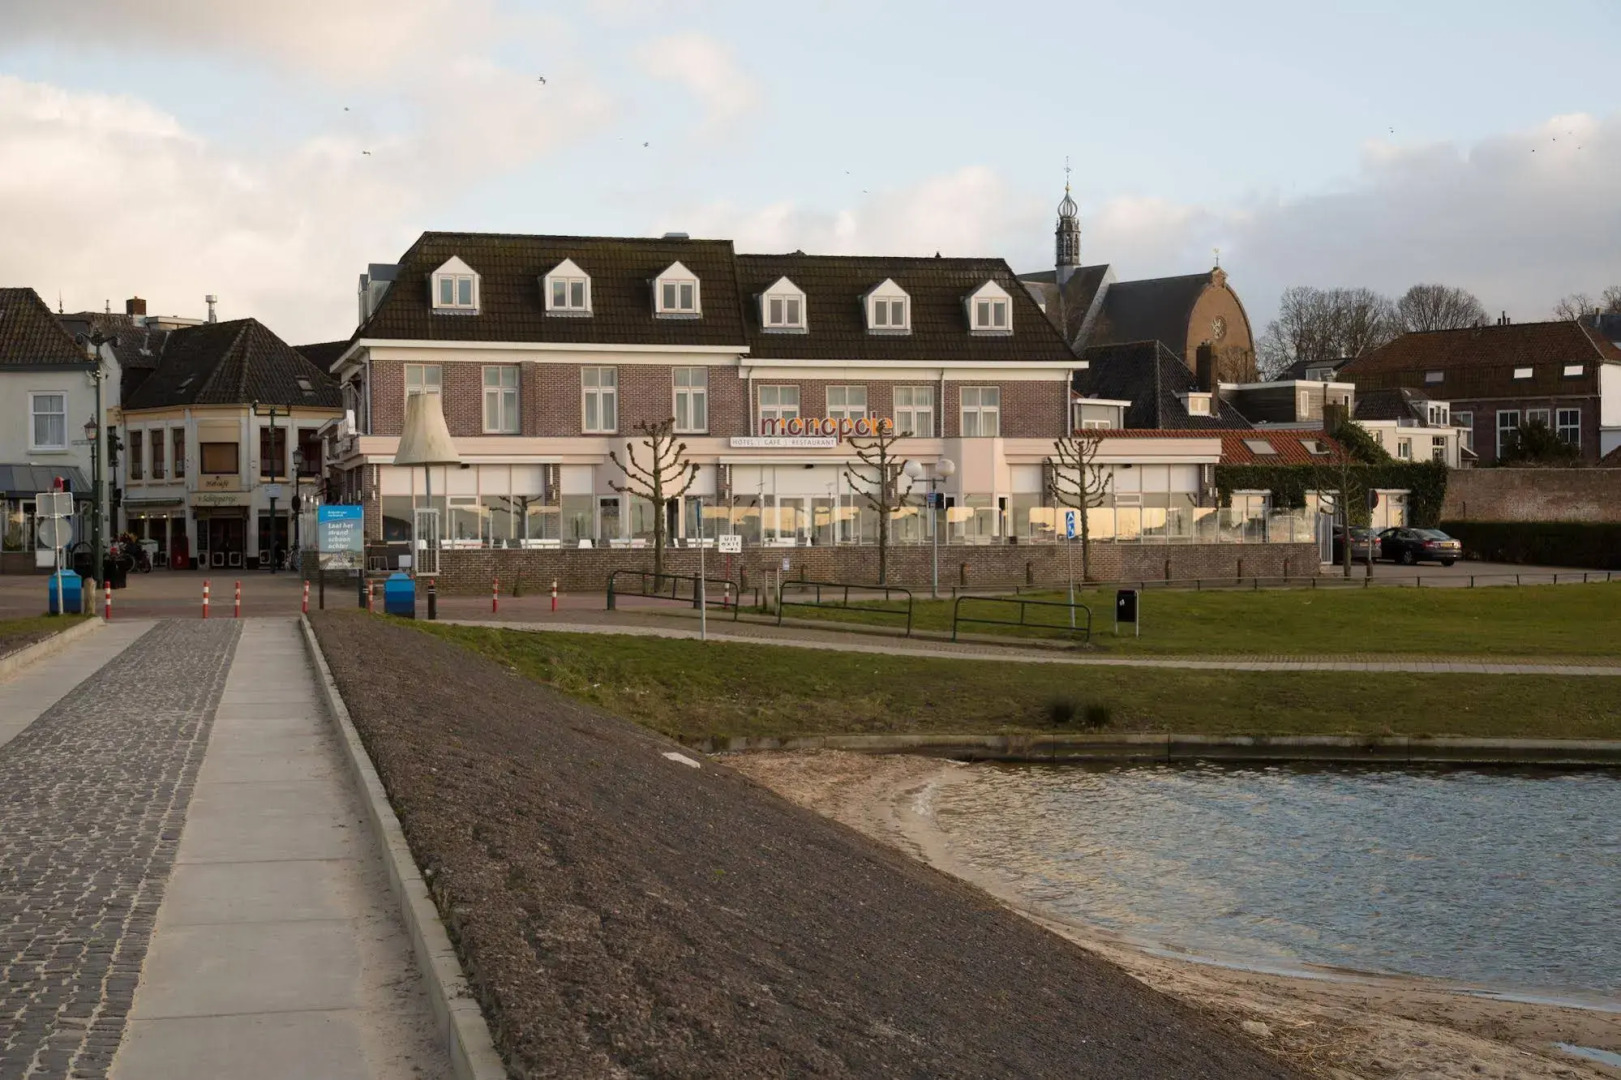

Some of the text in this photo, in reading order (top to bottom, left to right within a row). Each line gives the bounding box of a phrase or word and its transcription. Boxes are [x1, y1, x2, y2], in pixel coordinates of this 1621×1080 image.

[761, 411, 893, 443] monopole
[732, 438, 754, 446] HOTEL
[791, 438, 835, 446] RESTAURANT
